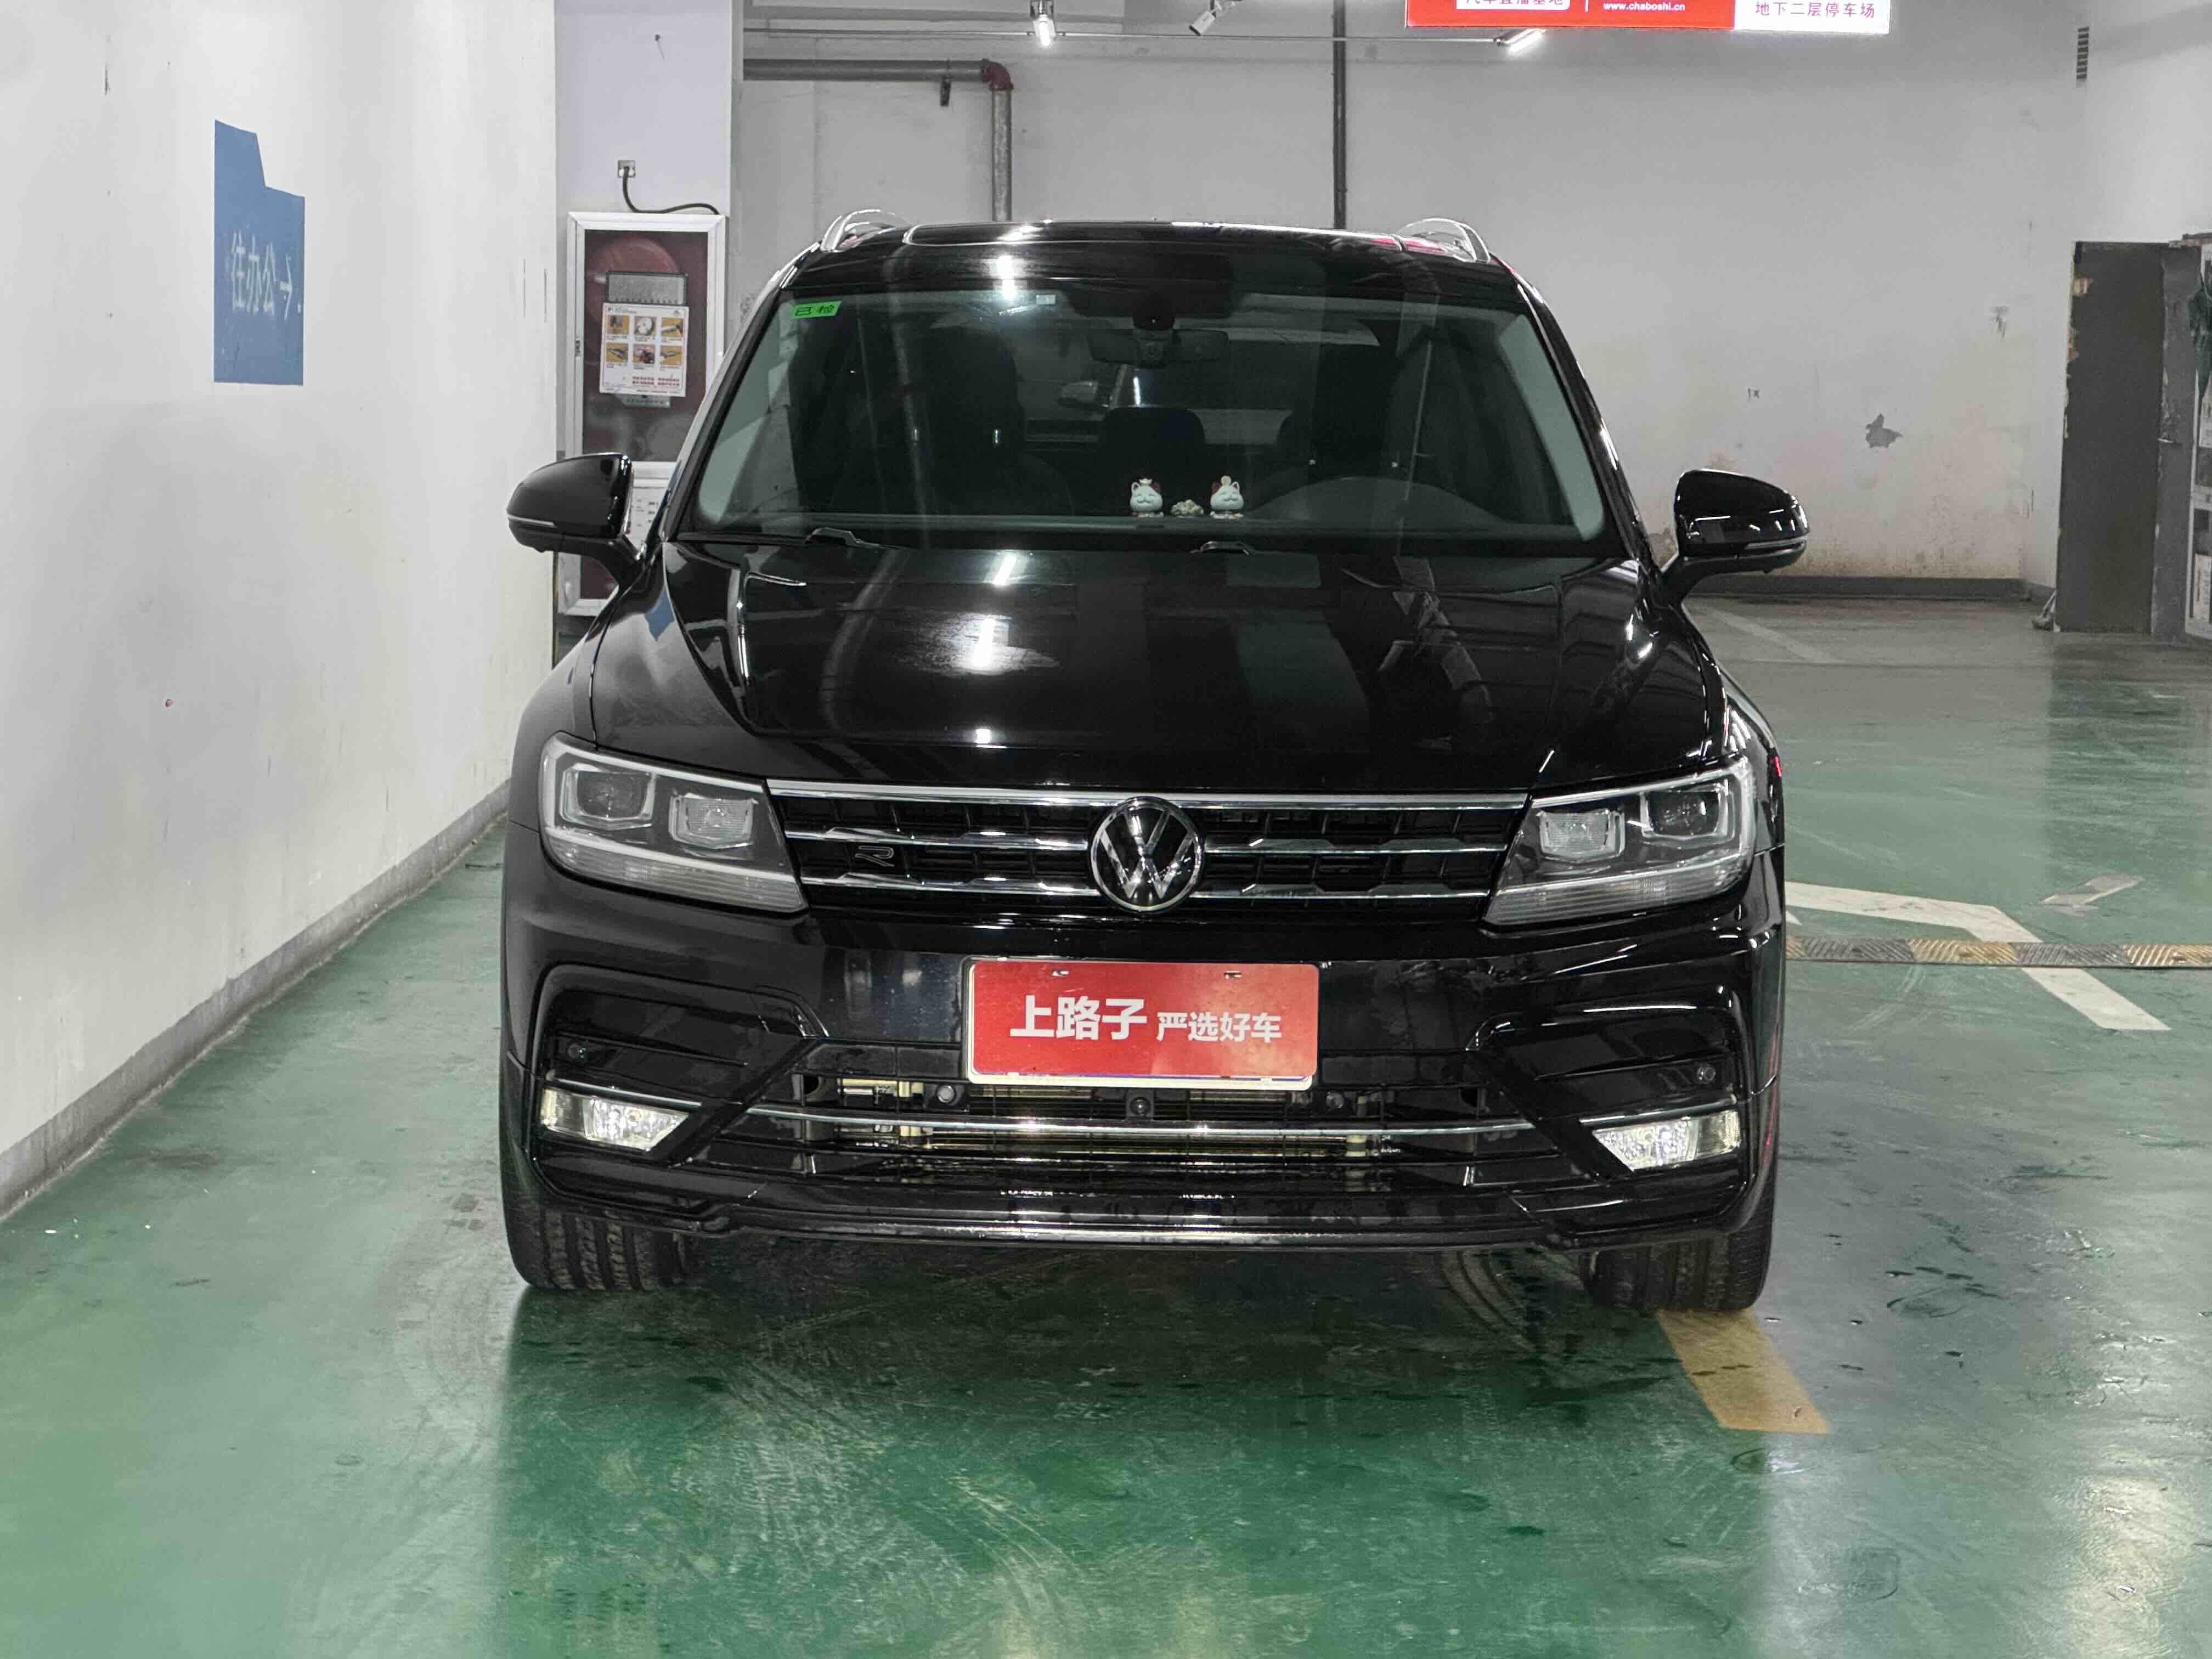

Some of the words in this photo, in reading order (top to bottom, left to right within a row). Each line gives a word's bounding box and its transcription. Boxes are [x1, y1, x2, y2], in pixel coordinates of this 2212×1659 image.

[1603, 2, 1686, 10] www.chaboshi.cn
[1755, 2, 1875, 18] 地下二层停车场
[1009, 994, 1148, 1041] 上路子
[1156, 1011, 1282, 1043] 严选好车
